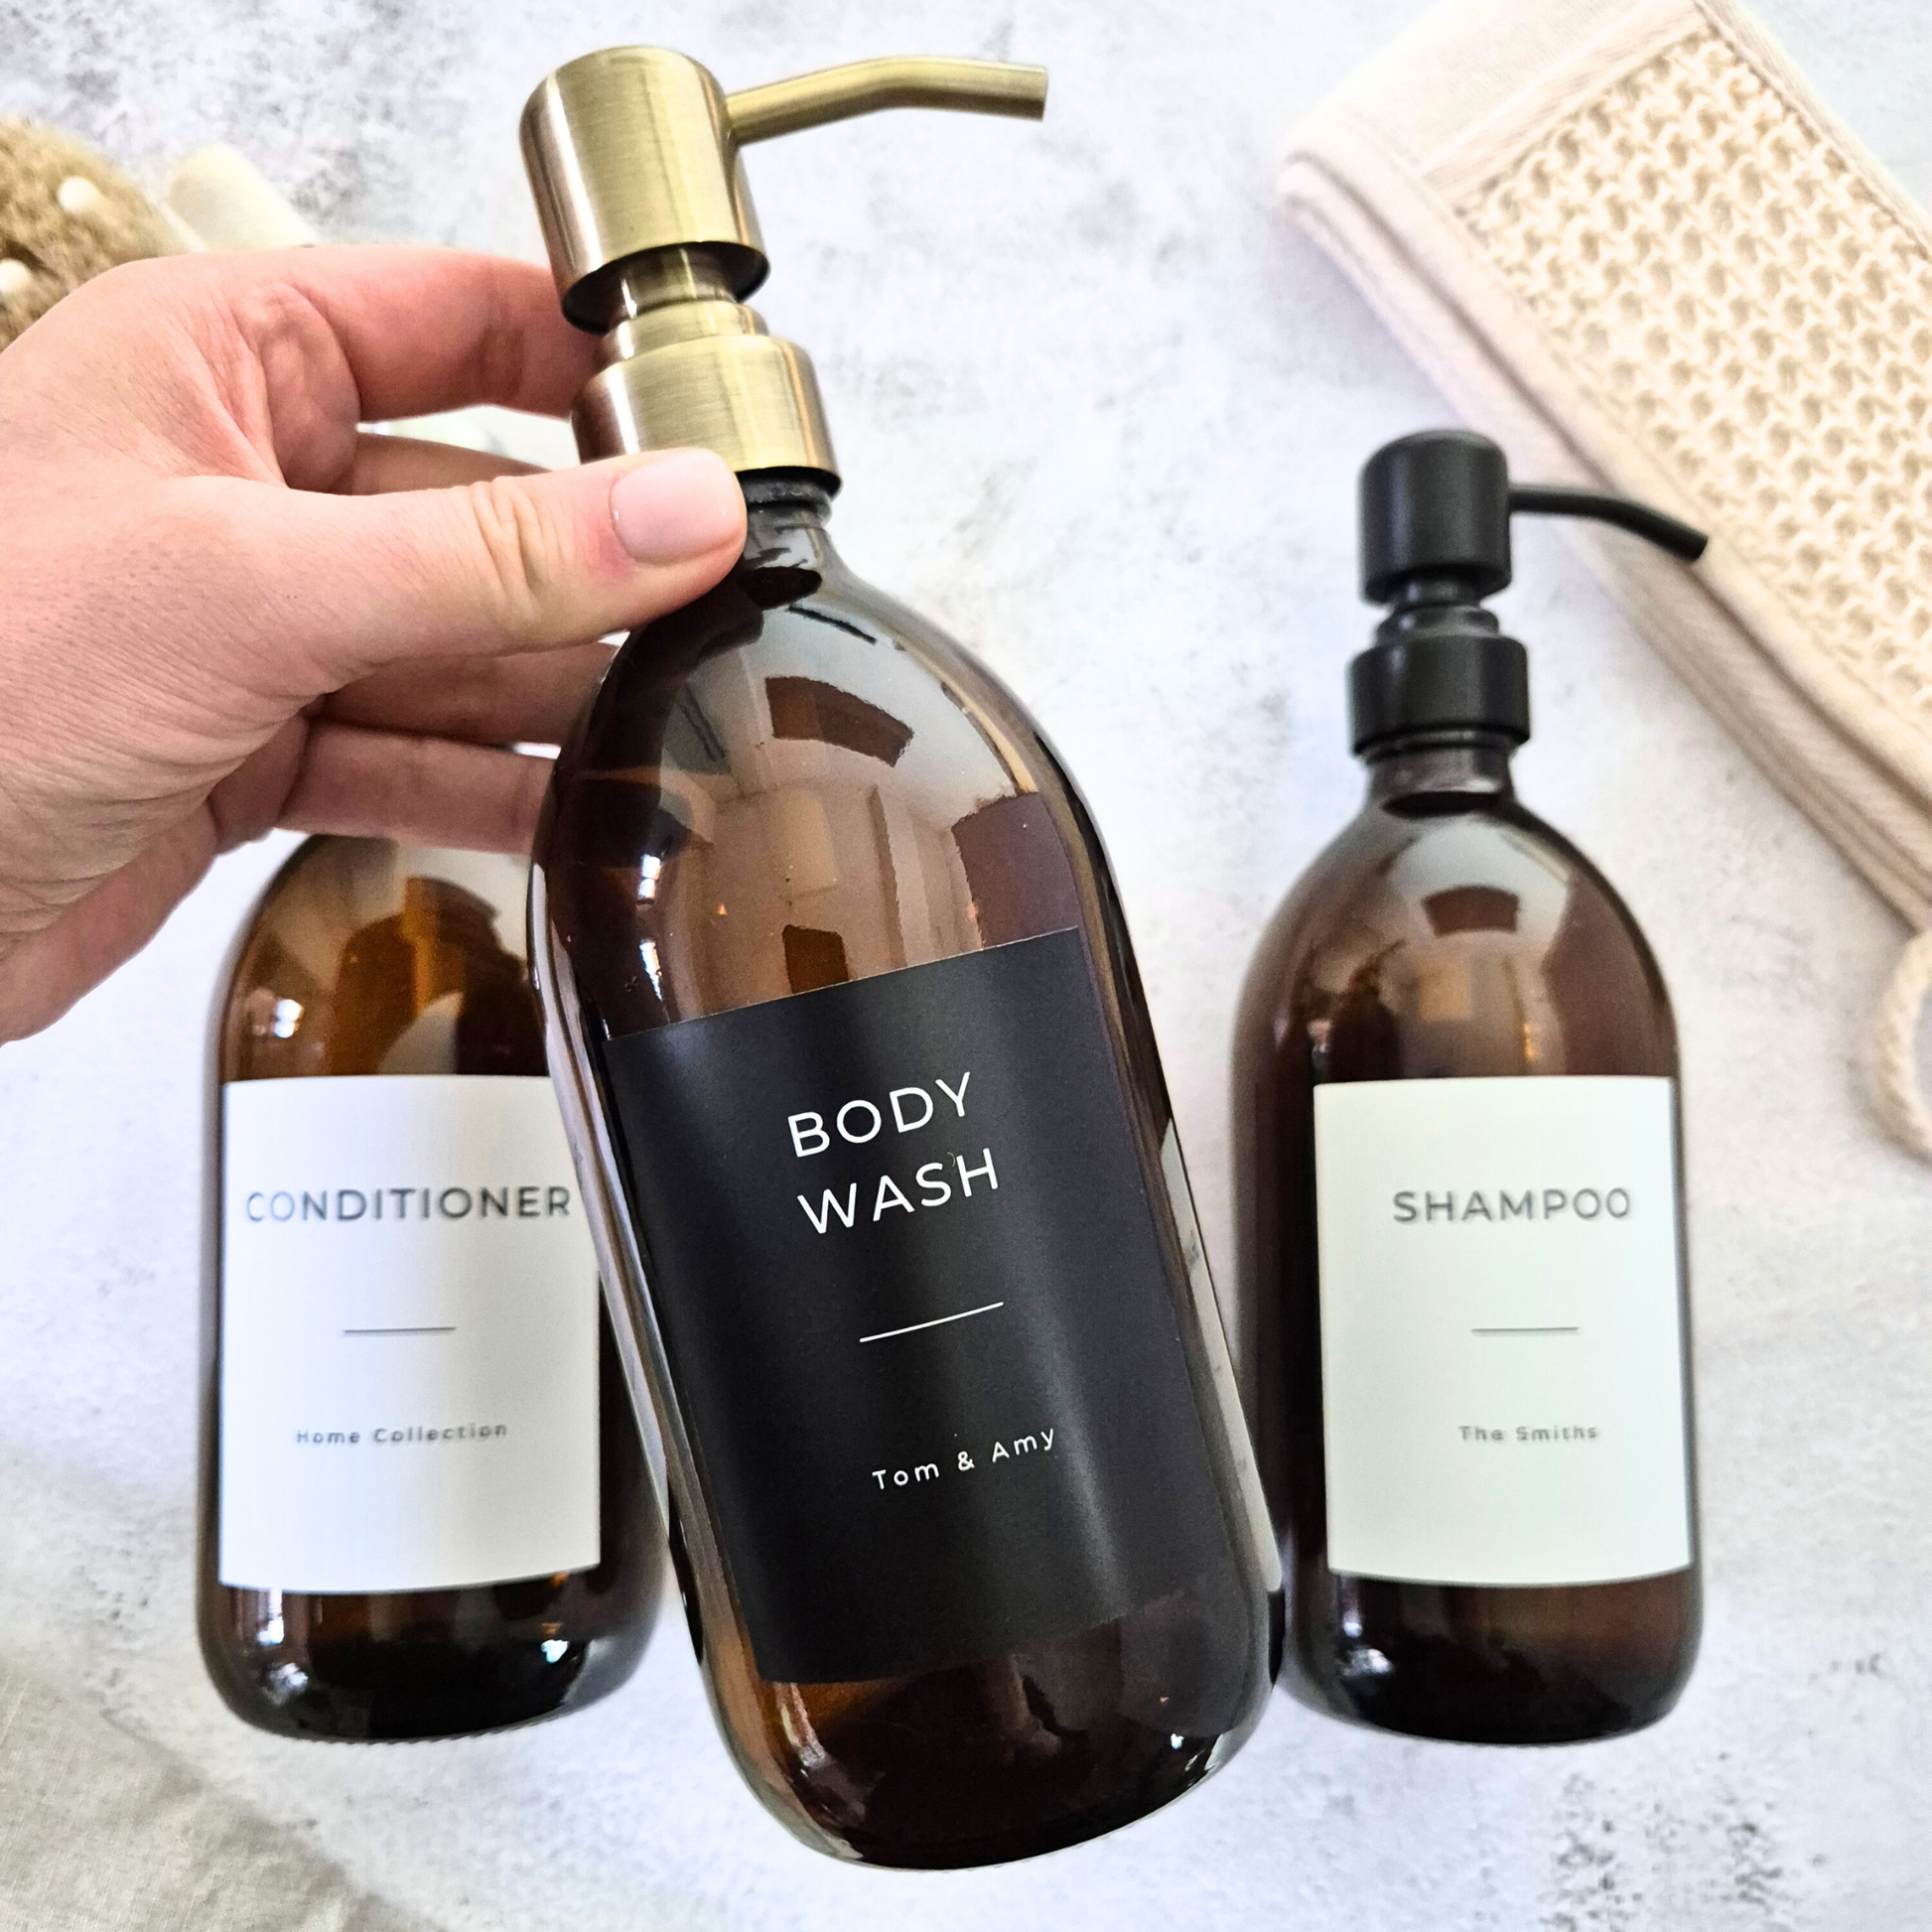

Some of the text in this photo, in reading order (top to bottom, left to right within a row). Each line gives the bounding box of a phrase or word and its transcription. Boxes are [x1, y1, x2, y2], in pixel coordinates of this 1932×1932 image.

[787, 1071, 971, 1158] BODY
[246, 1185, 571, 1222] CONDITIONER
[797, 1148, 999, 1234] WASH
[1393, 1187, 1631, 1222] SHAMPOO
[296, 1423, 508, 1445] Home Collection
[1458, 1424, 1598, 1443] The Smiths
[872, 1428, 1054, 1489] Tom & Amy
